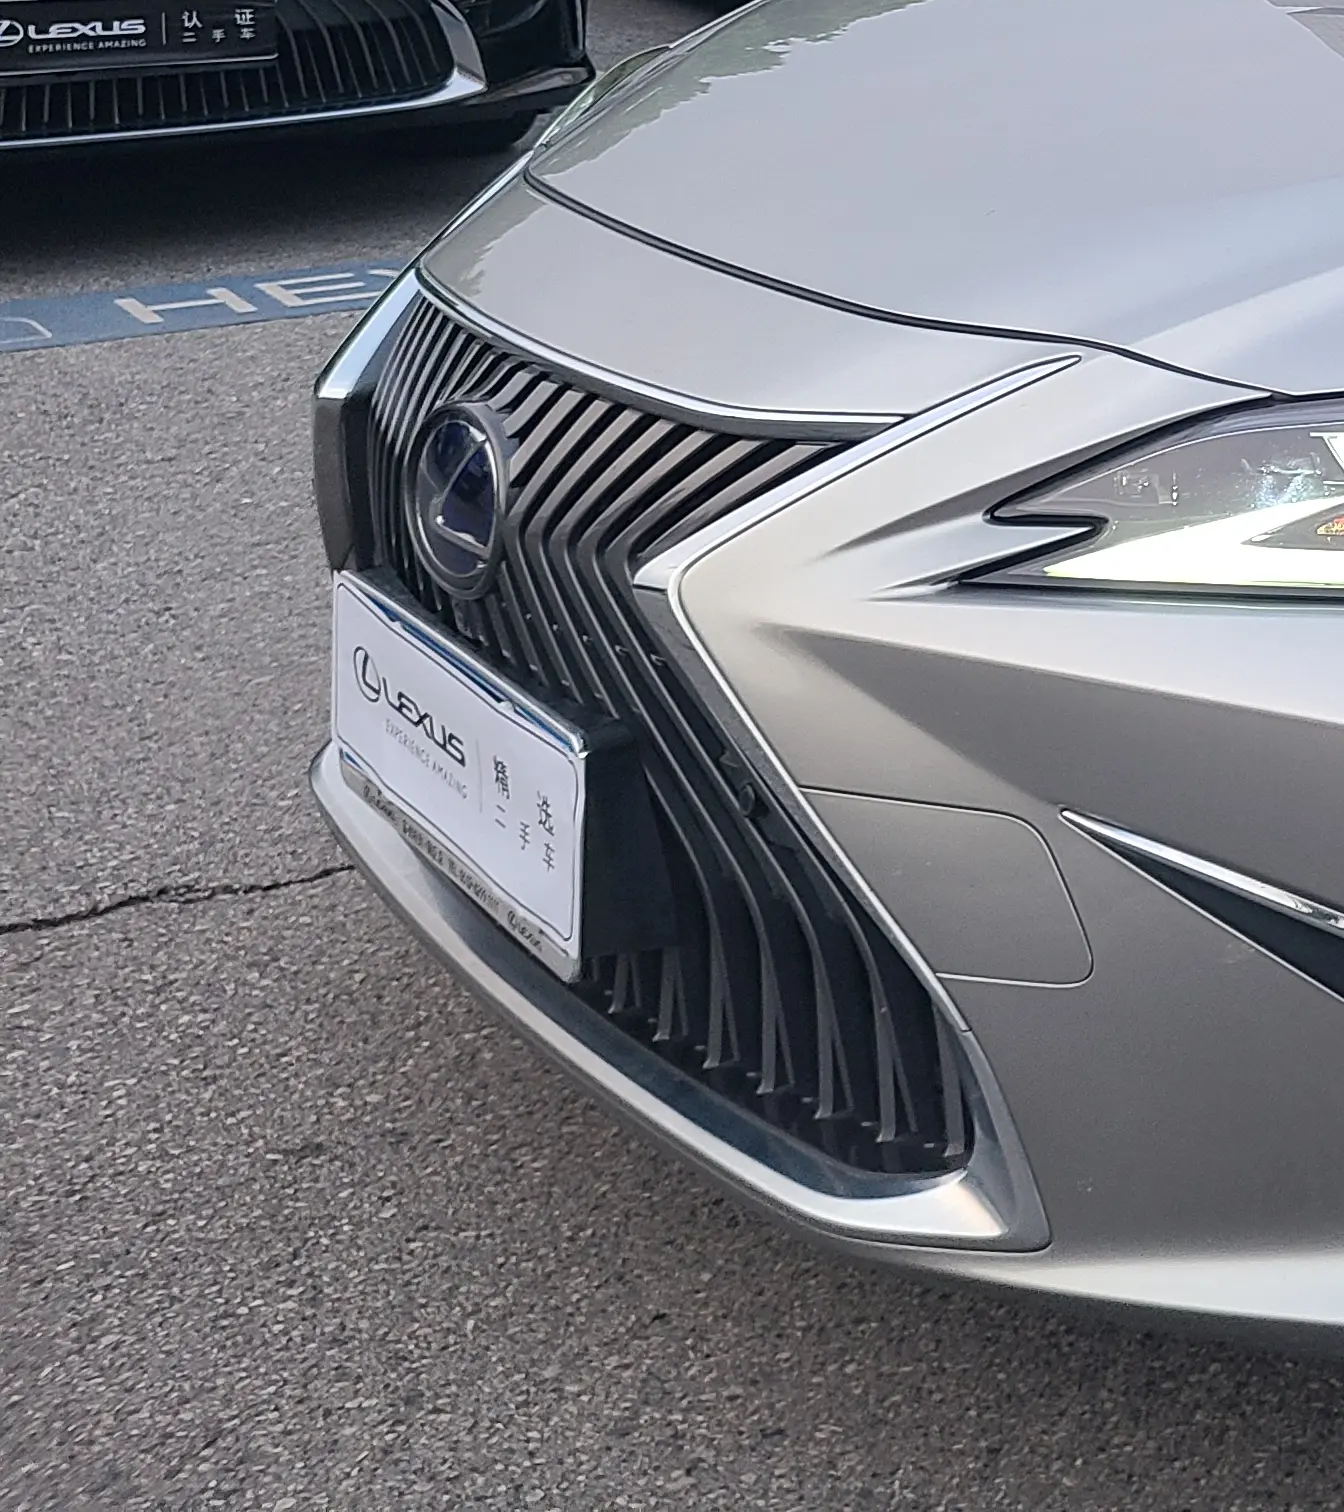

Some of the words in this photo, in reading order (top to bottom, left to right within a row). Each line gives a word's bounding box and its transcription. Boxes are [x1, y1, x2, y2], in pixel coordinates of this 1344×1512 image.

[27, 19, 146, 39] LEXUS
[182, 28, 257, 43] 二手车
[28, 41, 94, 54] EXPERIENCE
[98, 38, 147, 49] AMAZING
[382, 676, 466, 767] LEXUS
[495, 804, 556, 874] 二手车
